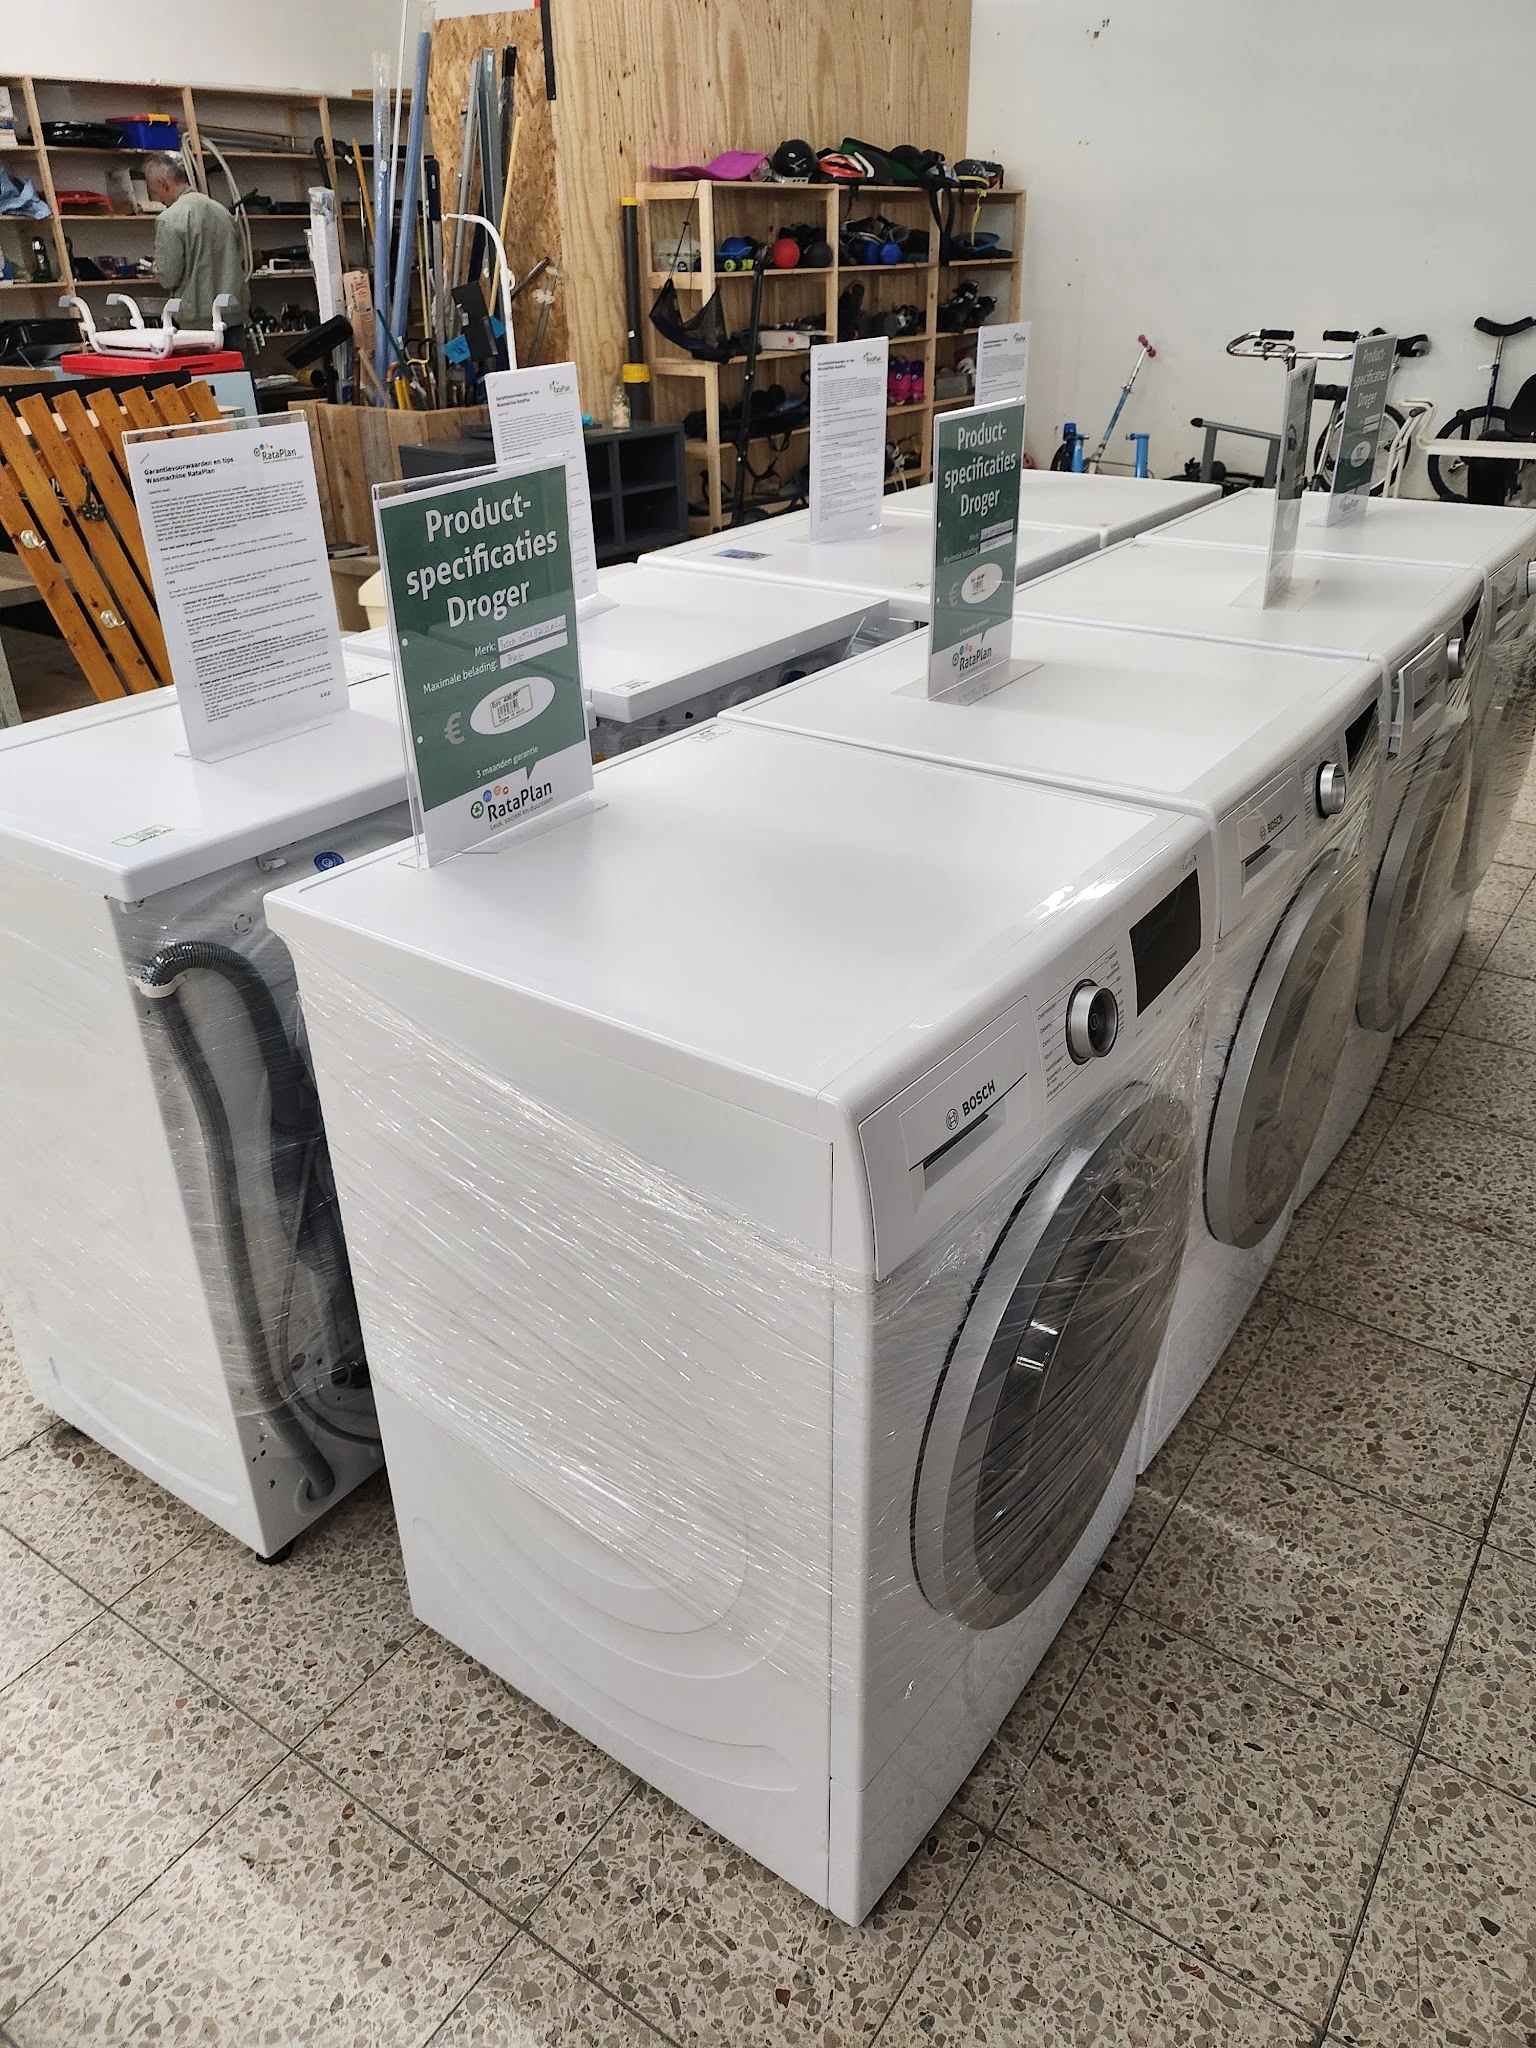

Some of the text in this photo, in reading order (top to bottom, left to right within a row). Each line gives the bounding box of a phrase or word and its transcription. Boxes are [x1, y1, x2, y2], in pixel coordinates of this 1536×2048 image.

[957, 420, 1007, 451] Product-
[144, 460, 213, 476] Garantievoorwaarden
[222, 457, 234, 465] tips
[262, 449, 296, 461] RataPlan
[944, 449, 1016, 494] specificaties
[146, 468, 216, 484] Wasmachine RataPlan
[425, 490, 532, 543] Product-
[960, 488, 1001, 517] Droger
[406, 529, 558, 600] specificaties
[447, 581, 530, 628] Droger
[474, 643, 497, 657] Merk:
[959, 647, 992, 671] RataPlan
[423, 660, 498, 695] Maximale belading:
[443, 711, 465, 745] €
[476, 745, 539, 779] 3 maanden garantie
[487, 782, 552, 822] RataPlan
[962, 1079, 996, 1117] BOSCH
